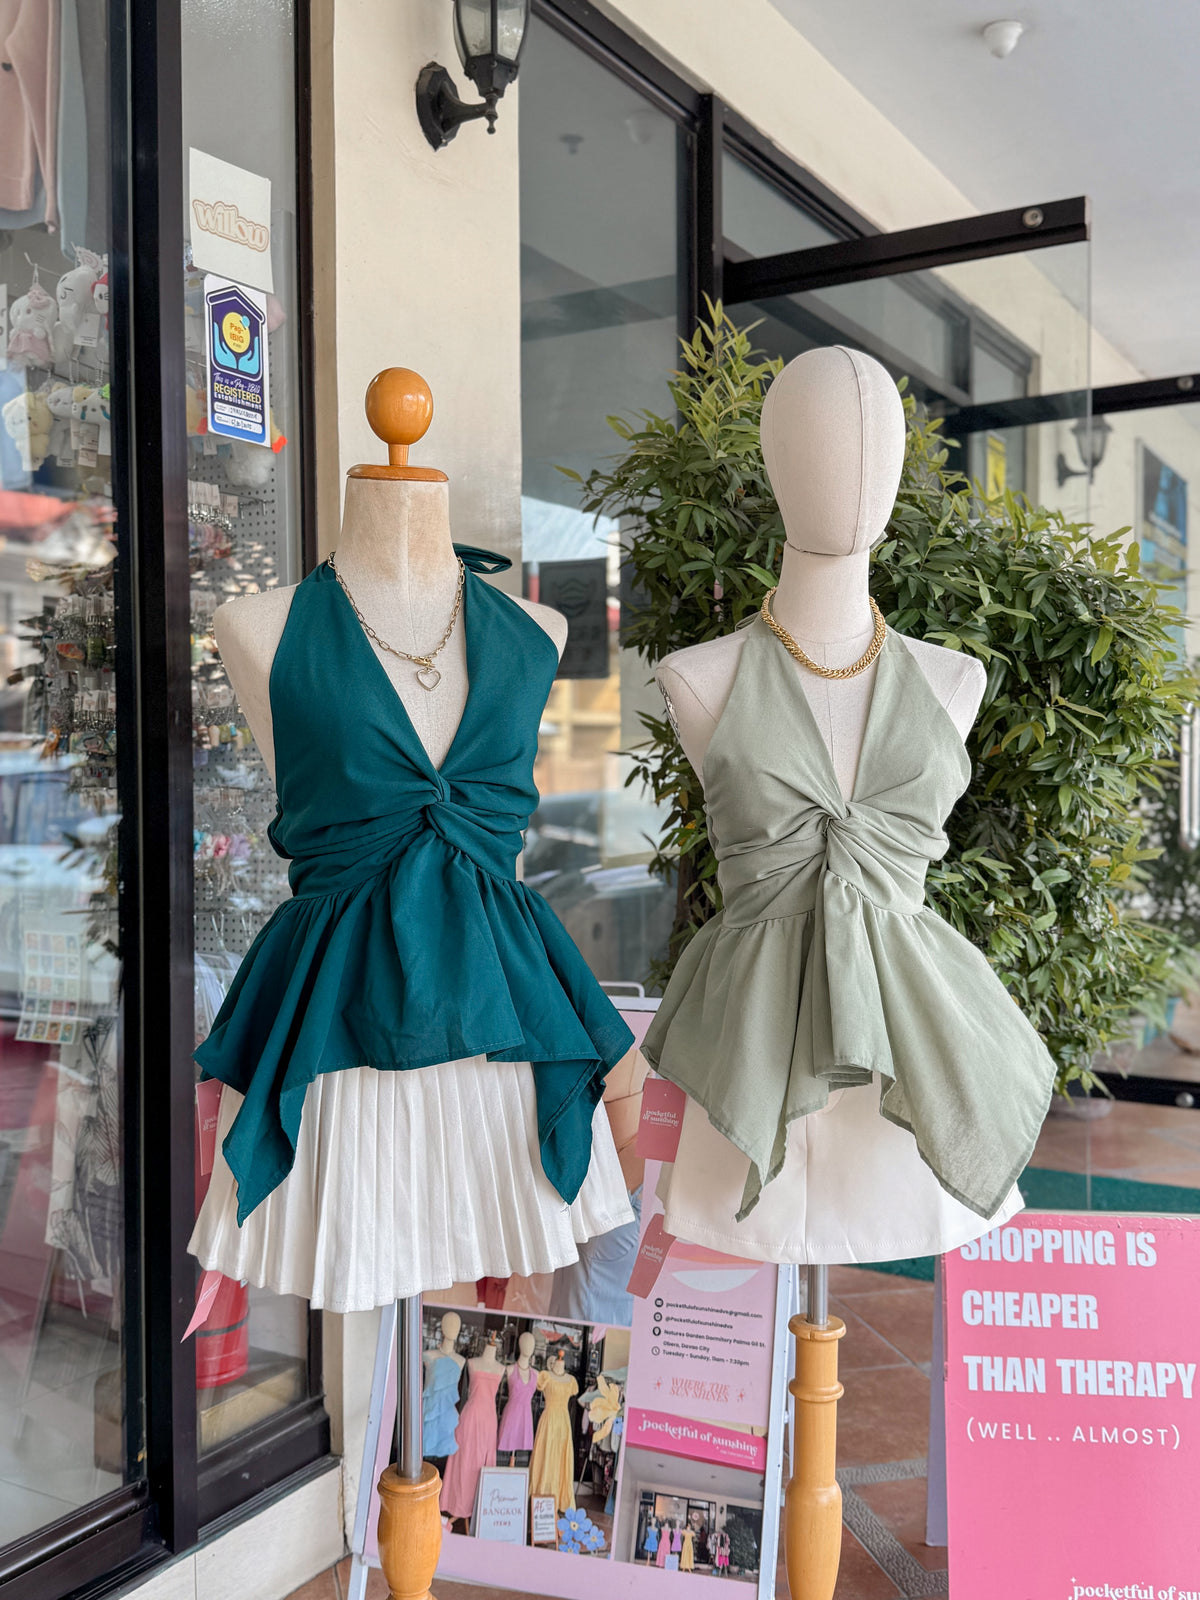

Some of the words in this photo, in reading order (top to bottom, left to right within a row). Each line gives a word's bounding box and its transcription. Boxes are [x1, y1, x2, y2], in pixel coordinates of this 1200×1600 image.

[230, 332, 244, 343] IBIG
[213, 382, 262, 404] REGISTERED
[214, 391, 262, 410] Establishment
[960, 1227, 1116, 1266] SHOPPING
[1126, 1231, 1157, 1267] IS
[962, 1289, 1099, 1330] CHEAPER
[662, 1349, 685, 1358] Tuesday
[699, 1344, 710, 1352] City
[671, 1377, 707, 1392] WHERE
[709, 1382, 729, 1394] THE
[963, 1355, 1047, 1393] THAN
[1056, 1358, 1196, 1399] THERAPY
[638, 1419, 698, 1440] pocketful
[700, 1432, 712, 1443] of
[712, 1436, 758, 1457] sunshine
[967, 1416, 1037, 1442] (WELL
[1072, 1424, 1180, 1449] ALMOST)
[483, 1507, 522, 1516] BANGKOK
[1068, 1583, 1154, 1600] pocketful
[1157, 1586, 1176, 1600] of
